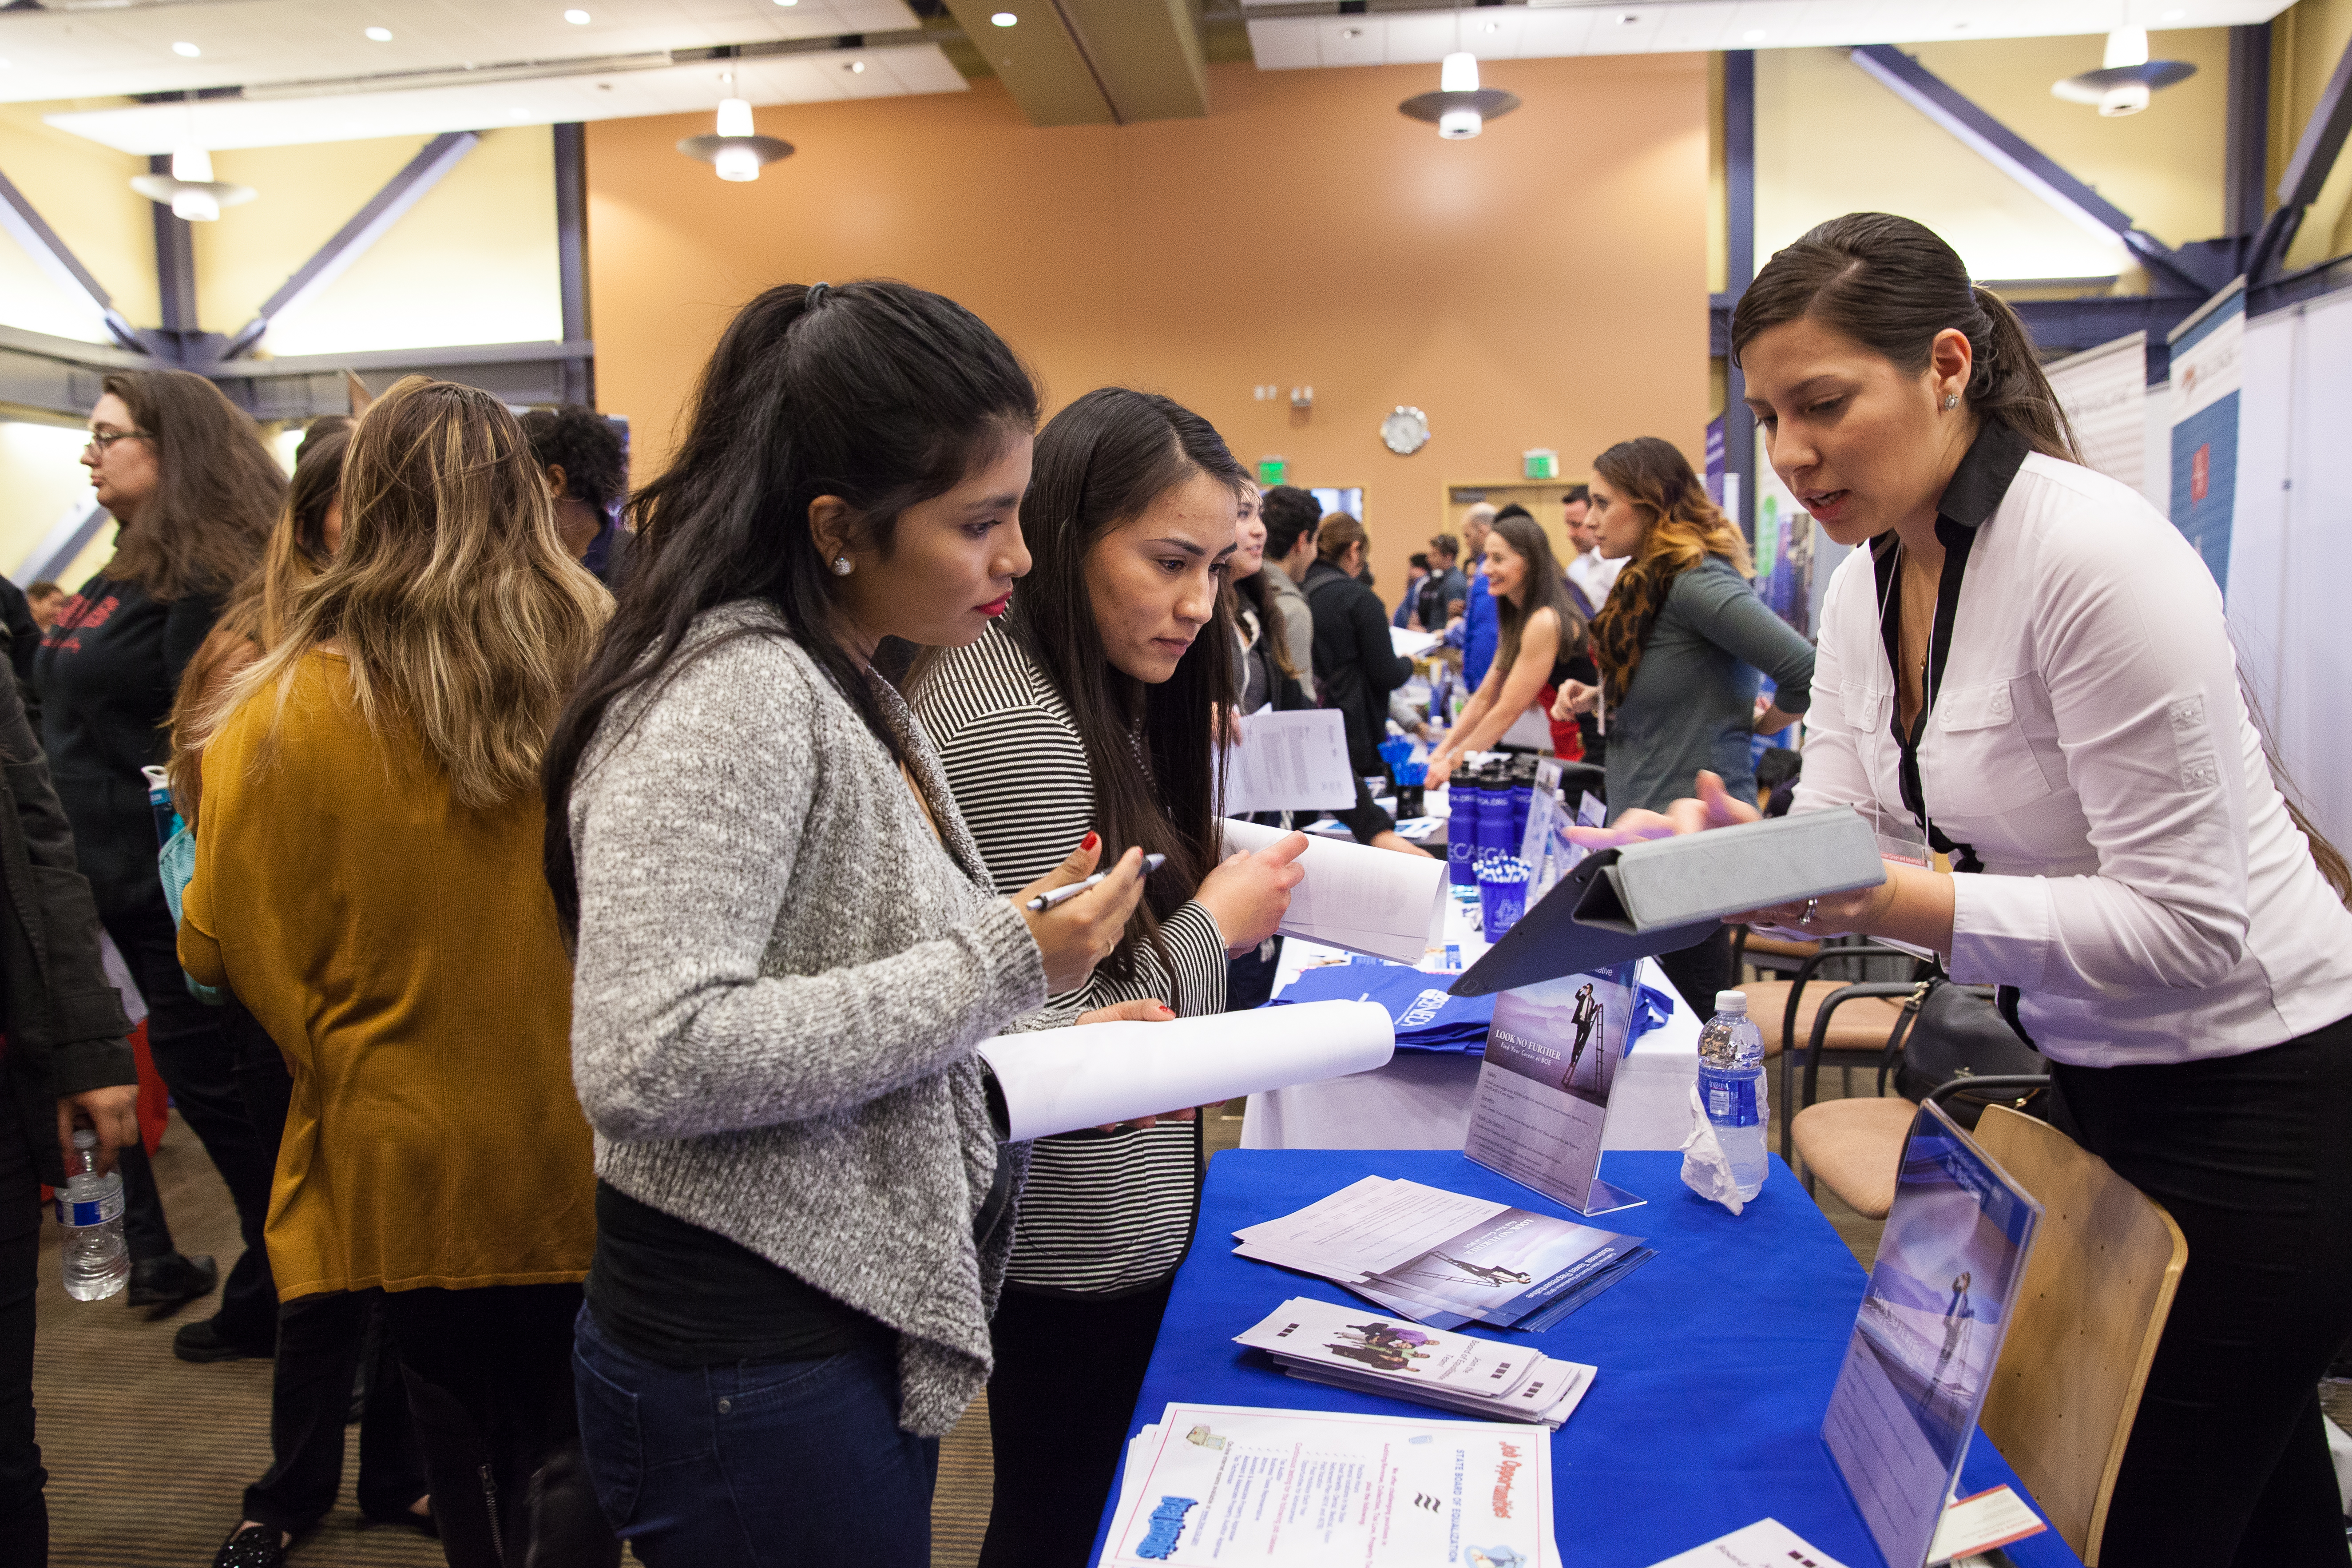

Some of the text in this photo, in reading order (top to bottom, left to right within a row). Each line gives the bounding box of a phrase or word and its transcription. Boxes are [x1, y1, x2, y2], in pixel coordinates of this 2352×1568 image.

[1495, 1029, 1561, 1060] LOOK NO FURTHER
[1501, 1042, 1510, 1050] Find
[1511, 1045, 1520, 1054] Your
[1521, 1050, 1535, 1060] Career
[1463, 1219, 1534, 1255] LOOK NO FURTHER
[1585, 1247, 1615, 1263] Business
[1568, 1262, 1590, 1273] Taxes
[1526, 1272, 1574, 1298] Representative
[1464, 1340, 1479, 1354] Board
[1438, 1359, 1465, 1380] Equalization
[1492, 1441, 1522, 1519] Job Opportunities
[1449, 1449, 1464, 1563] STATE BOARD OF EQUALIZATION
